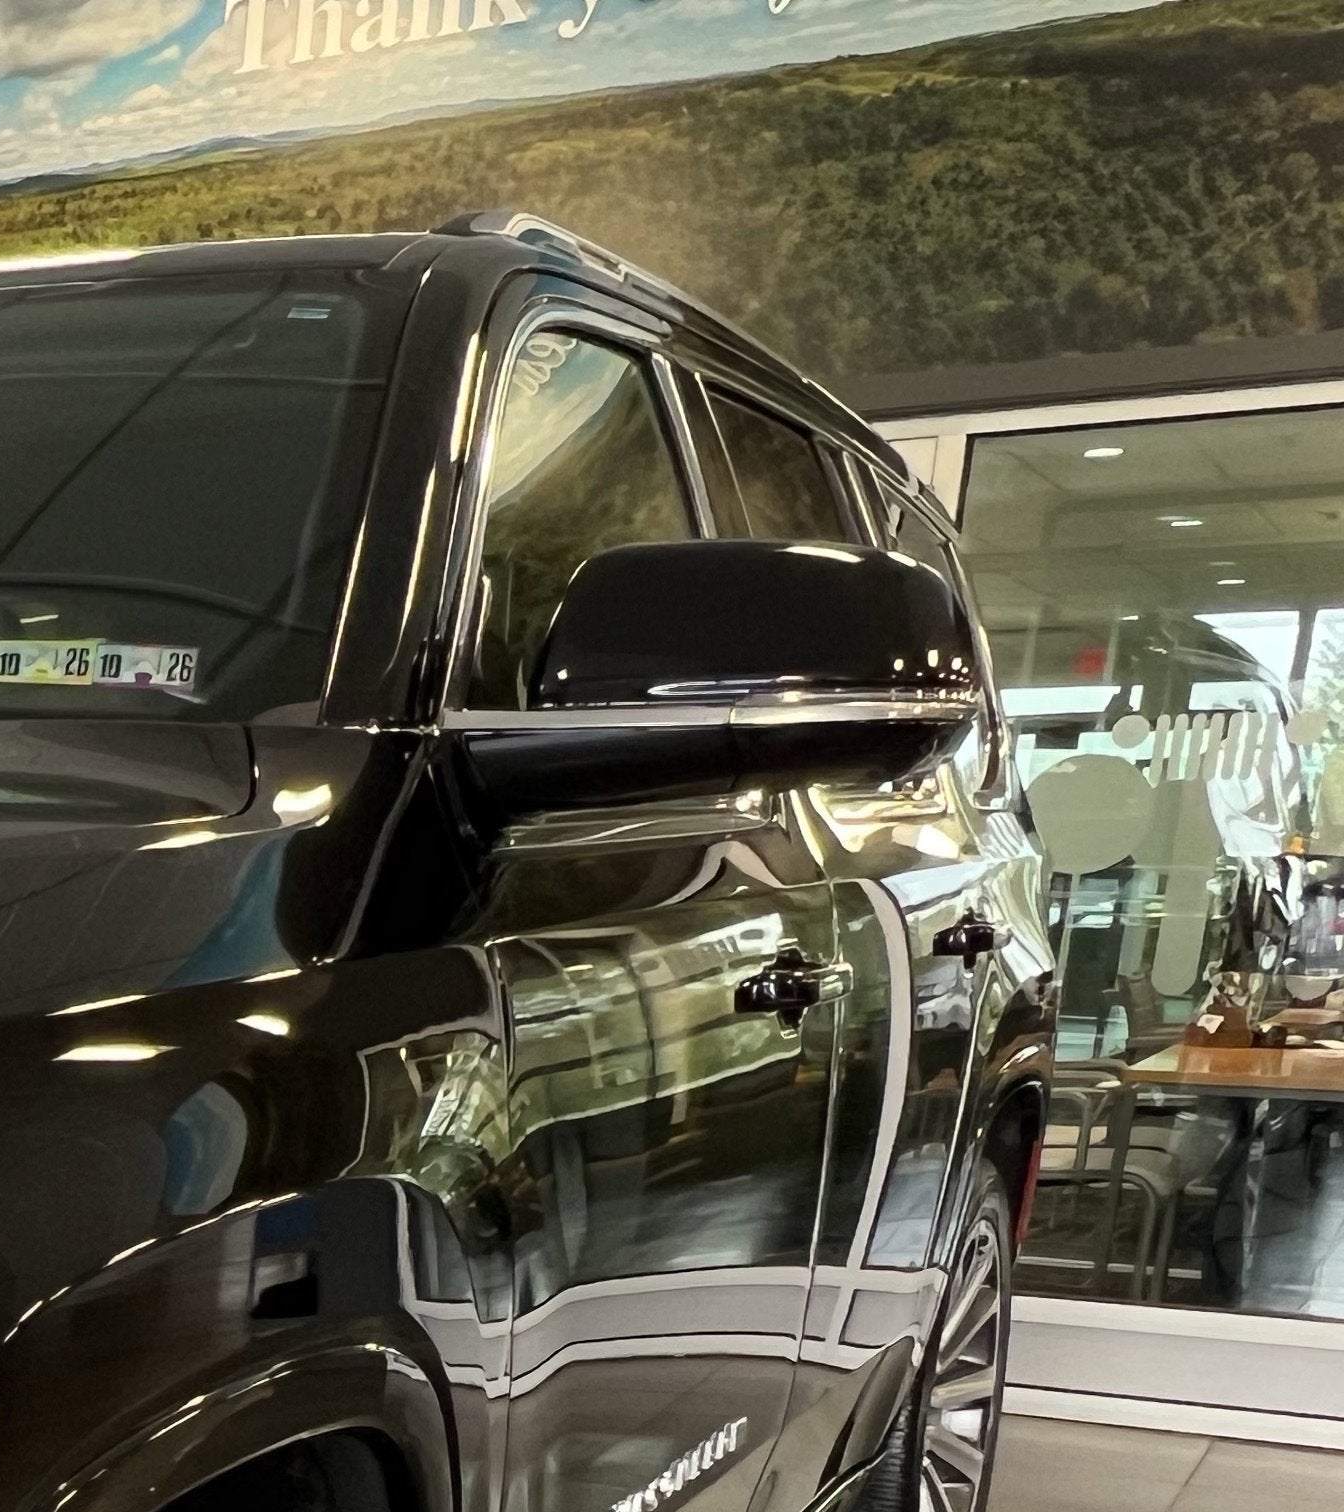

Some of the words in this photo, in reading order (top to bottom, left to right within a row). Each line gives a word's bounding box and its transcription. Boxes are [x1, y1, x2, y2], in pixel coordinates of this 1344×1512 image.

[0, 652, 21, 676] 10
[64, 648, 90, 677] 26
[100, 653, 123, 678] 10
[166, 652, 194, 682] 26
